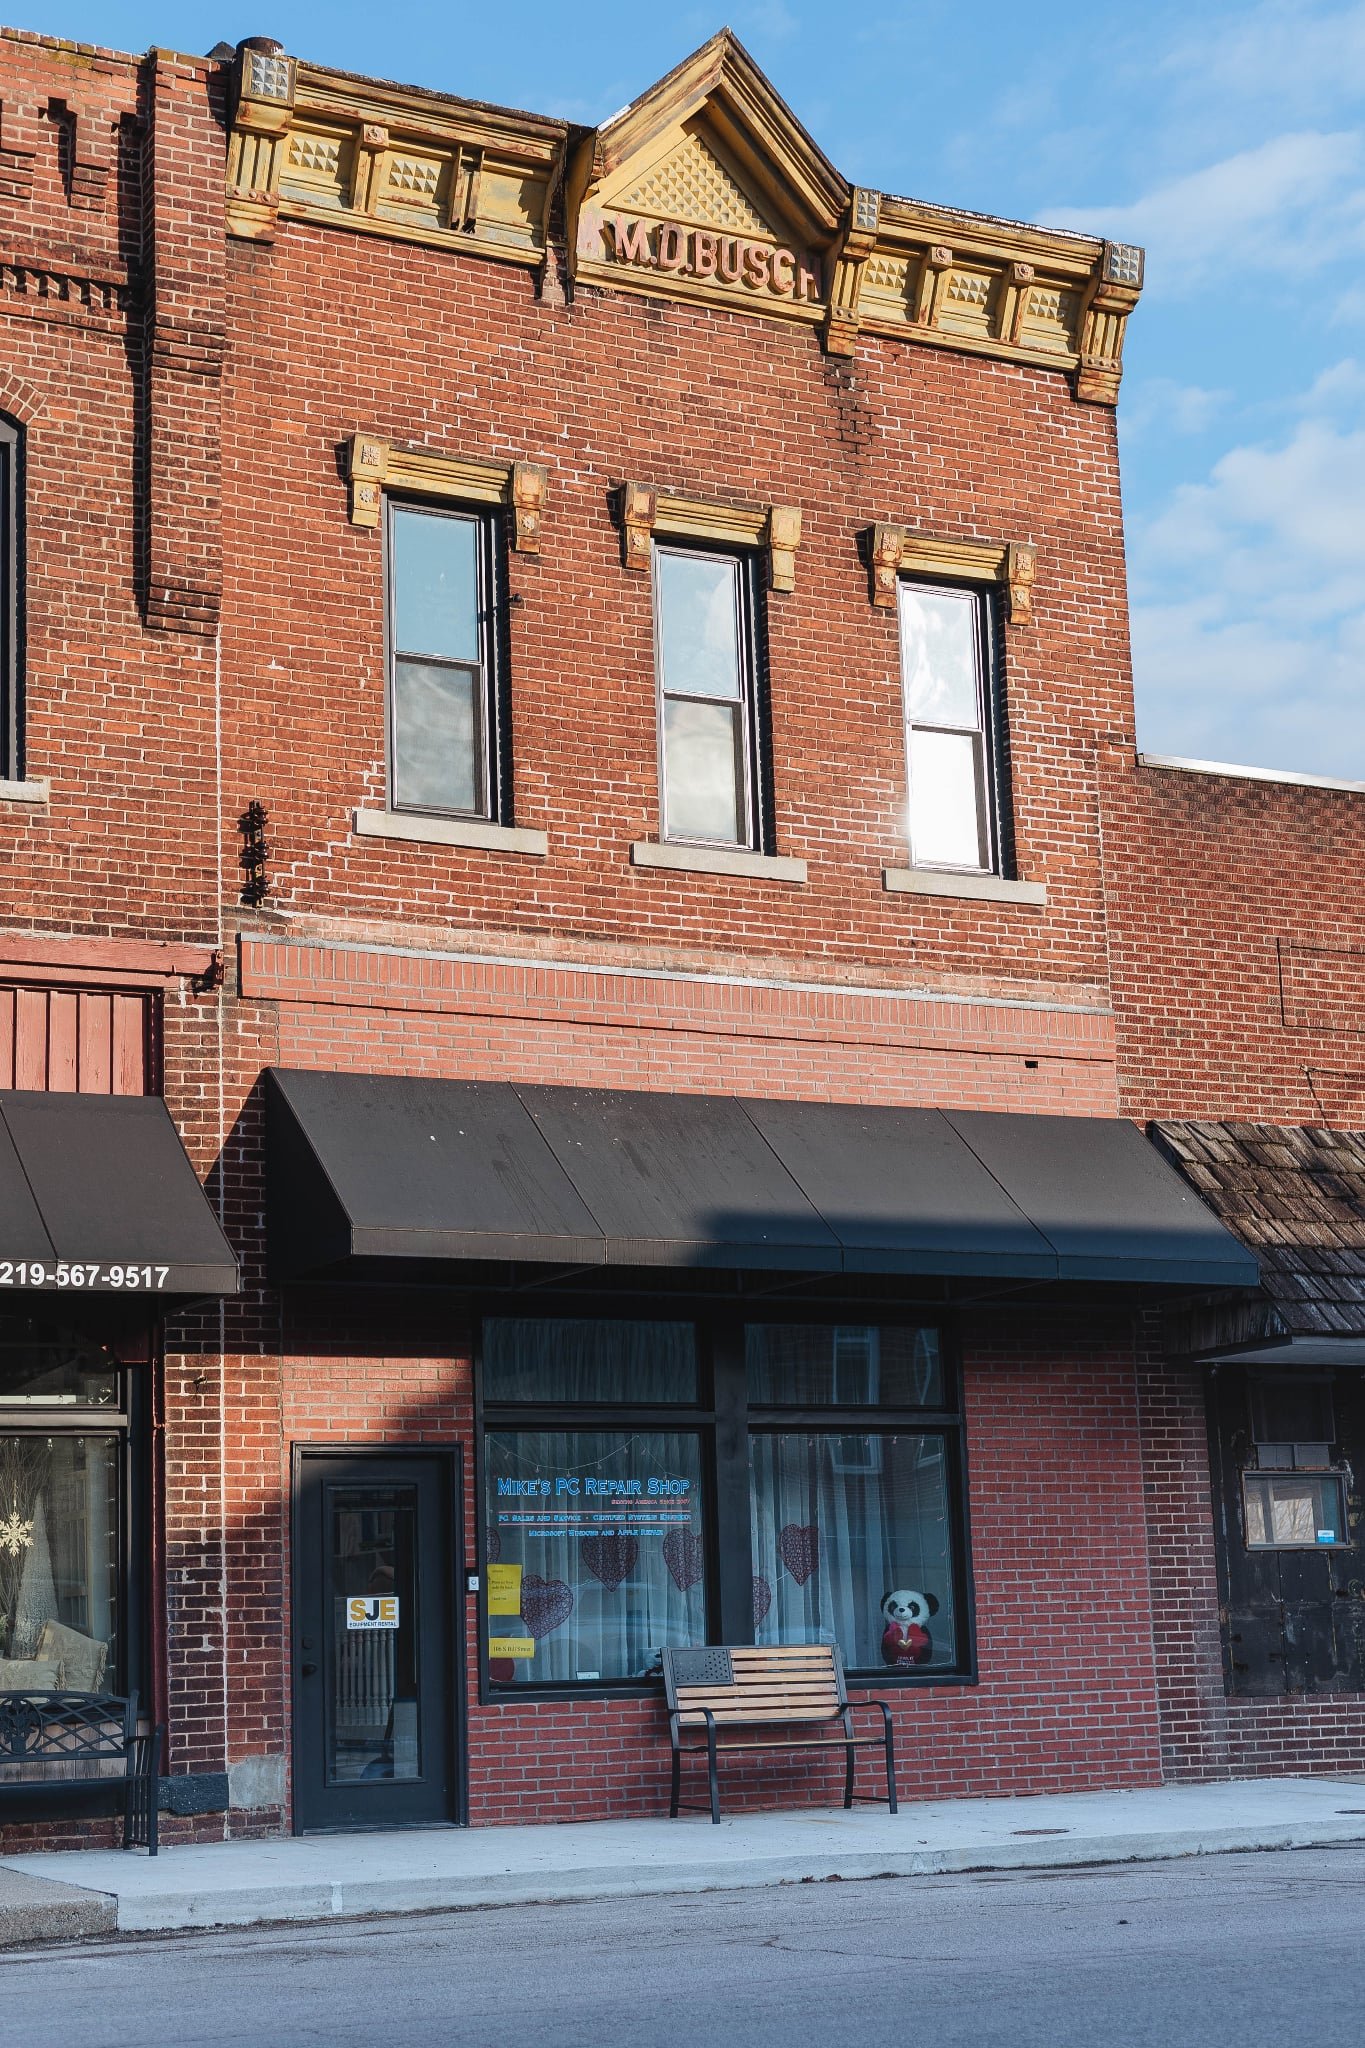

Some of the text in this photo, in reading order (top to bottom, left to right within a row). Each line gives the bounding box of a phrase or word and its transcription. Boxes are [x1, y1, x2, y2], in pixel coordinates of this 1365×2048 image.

[0, 1262, 170, 1289] 219-567-9517
[497, 1477, 690, 1496] MIKE'S PC REPAIR SHOP
[568, 1529, 599, 1537] WINDOWS
[640, 1528, 664, 1536] REPAIR
[350, 1599, 396, 1621] SJE
